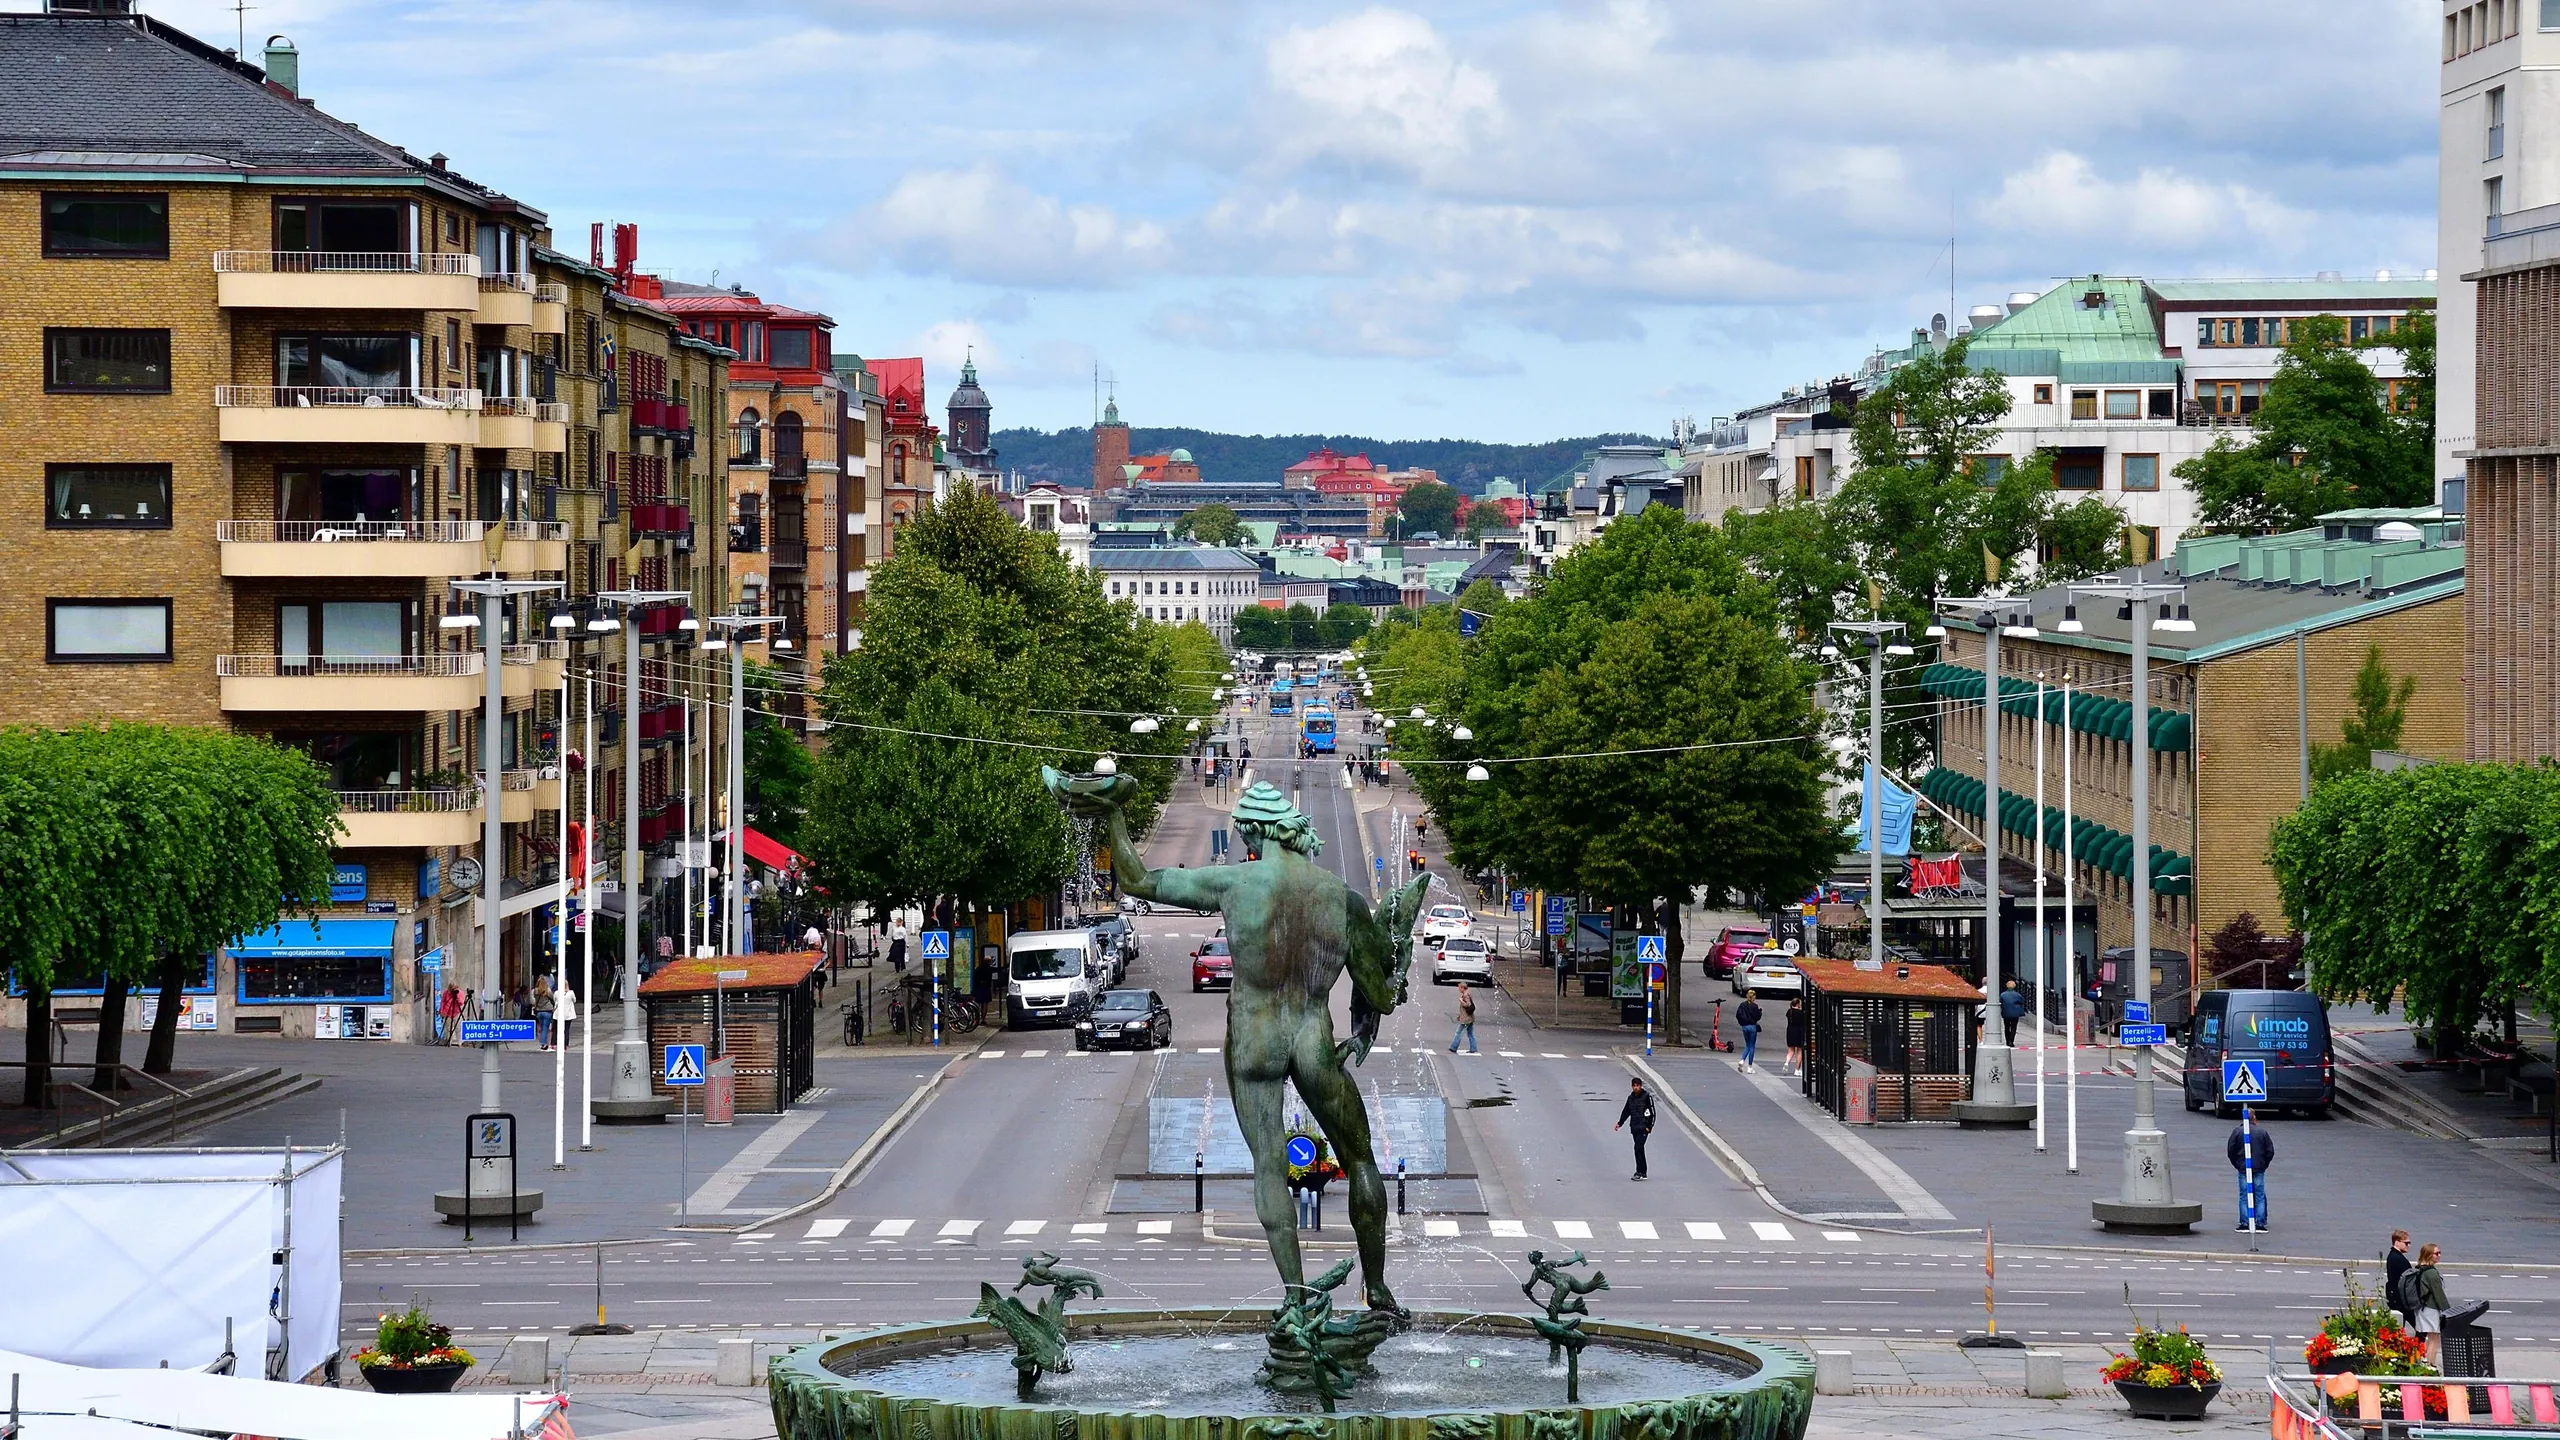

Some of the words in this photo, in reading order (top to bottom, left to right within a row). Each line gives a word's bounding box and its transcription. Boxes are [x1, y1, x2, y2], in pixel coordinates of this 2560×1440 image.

[1551, 898, 1559, 911] P
[1782, 922, 1799, 934] SK
[271, 949, 345, 957] www.gotaplatsensfoto.se
[491, 1023, 532, 1031] Rydbergs-
[2258, 1017, 2309, 1032] rimab
[2123, 1027, 2156, 1035] Berzelii-
[464, 1032, 487, 1040] gatan
[2124, 1036, 2145, 1044] gatan
[2258, 1041, 2285, 1049] 031-49
[2287, 1041, 2297, 1049] 53
[2298, 1041, 2308, 1049] 50
